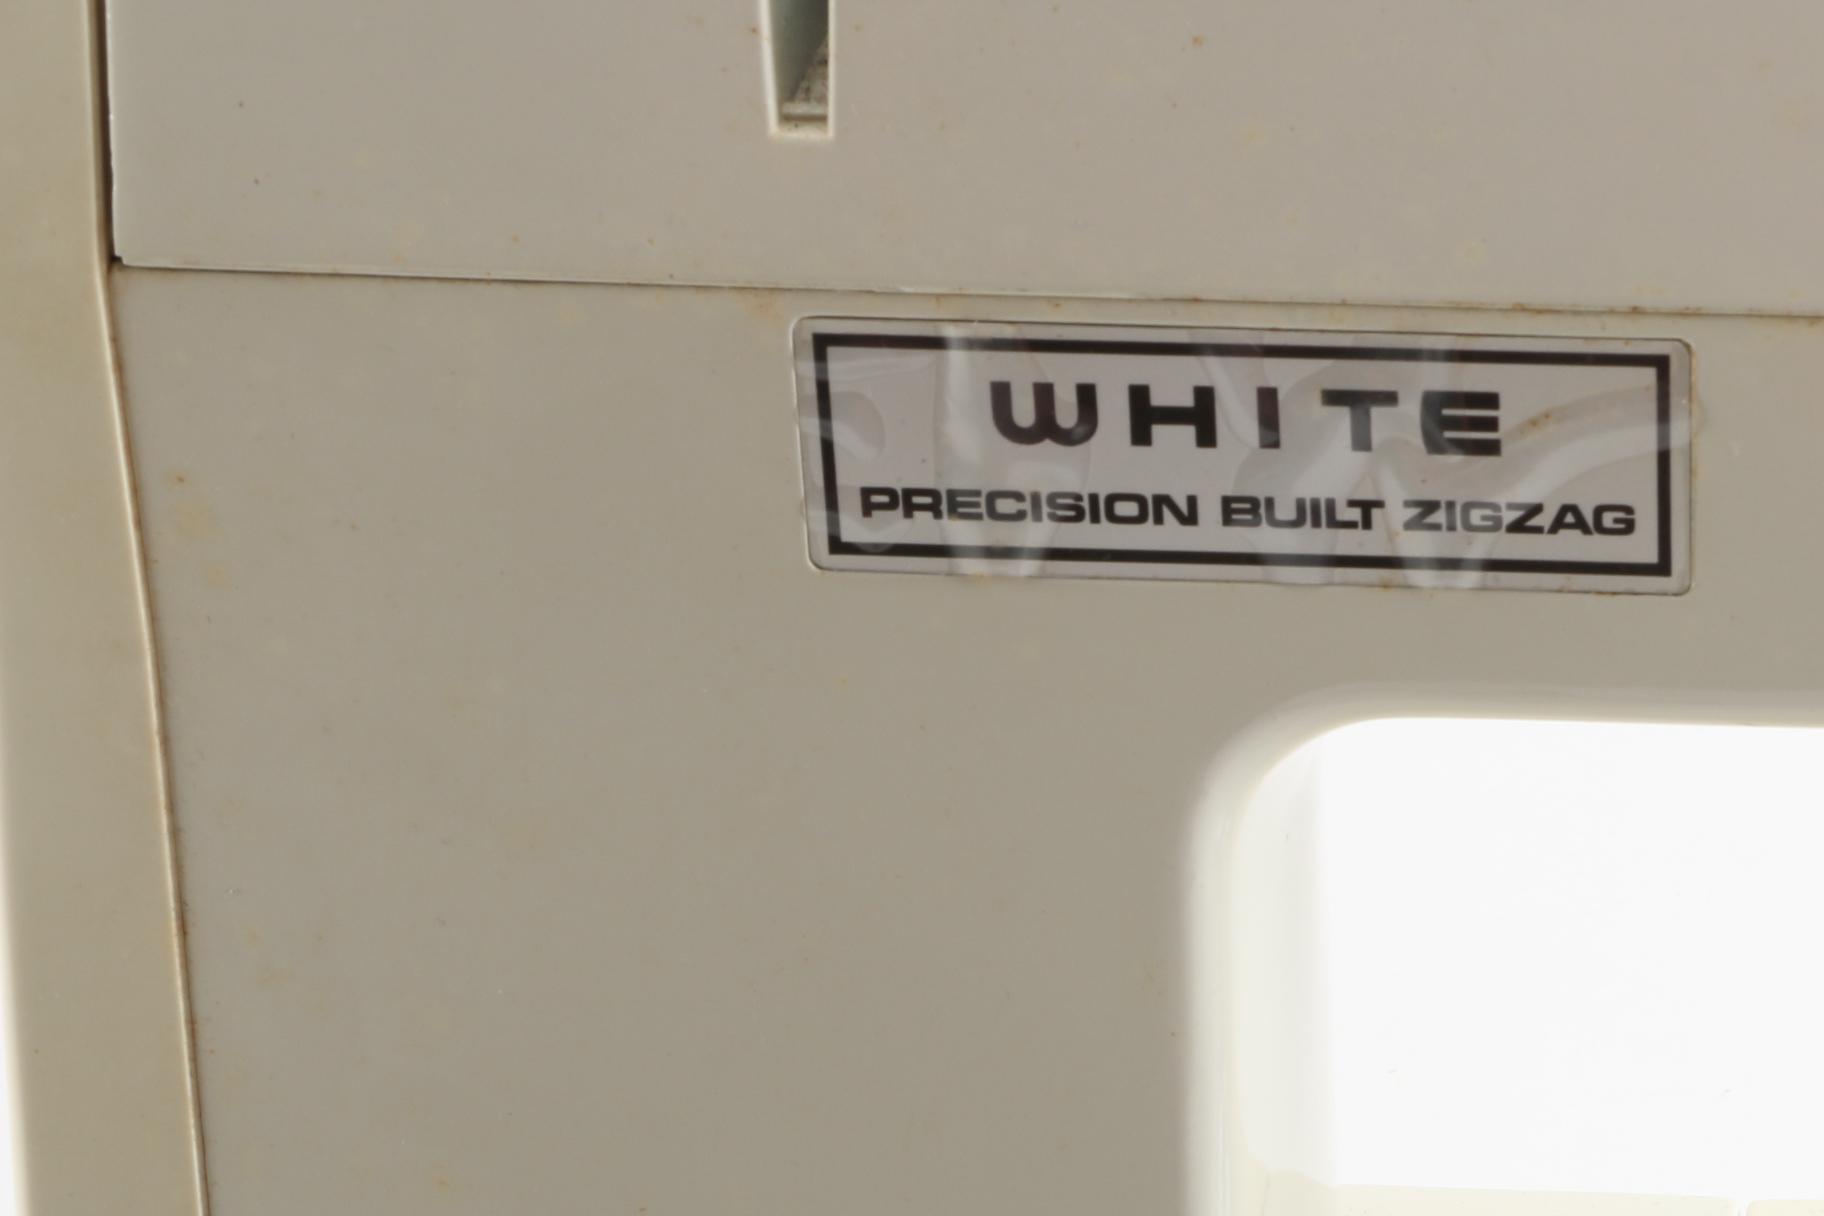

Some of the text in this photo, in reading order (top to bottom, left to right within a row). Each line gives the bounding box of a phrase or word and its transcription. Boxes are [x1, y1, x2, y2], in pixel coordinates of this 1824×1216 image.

[990, 380, 1503, 456] WHITE
[860, 486, 1636, 537] PRECISION BUILT ZIGZAG
